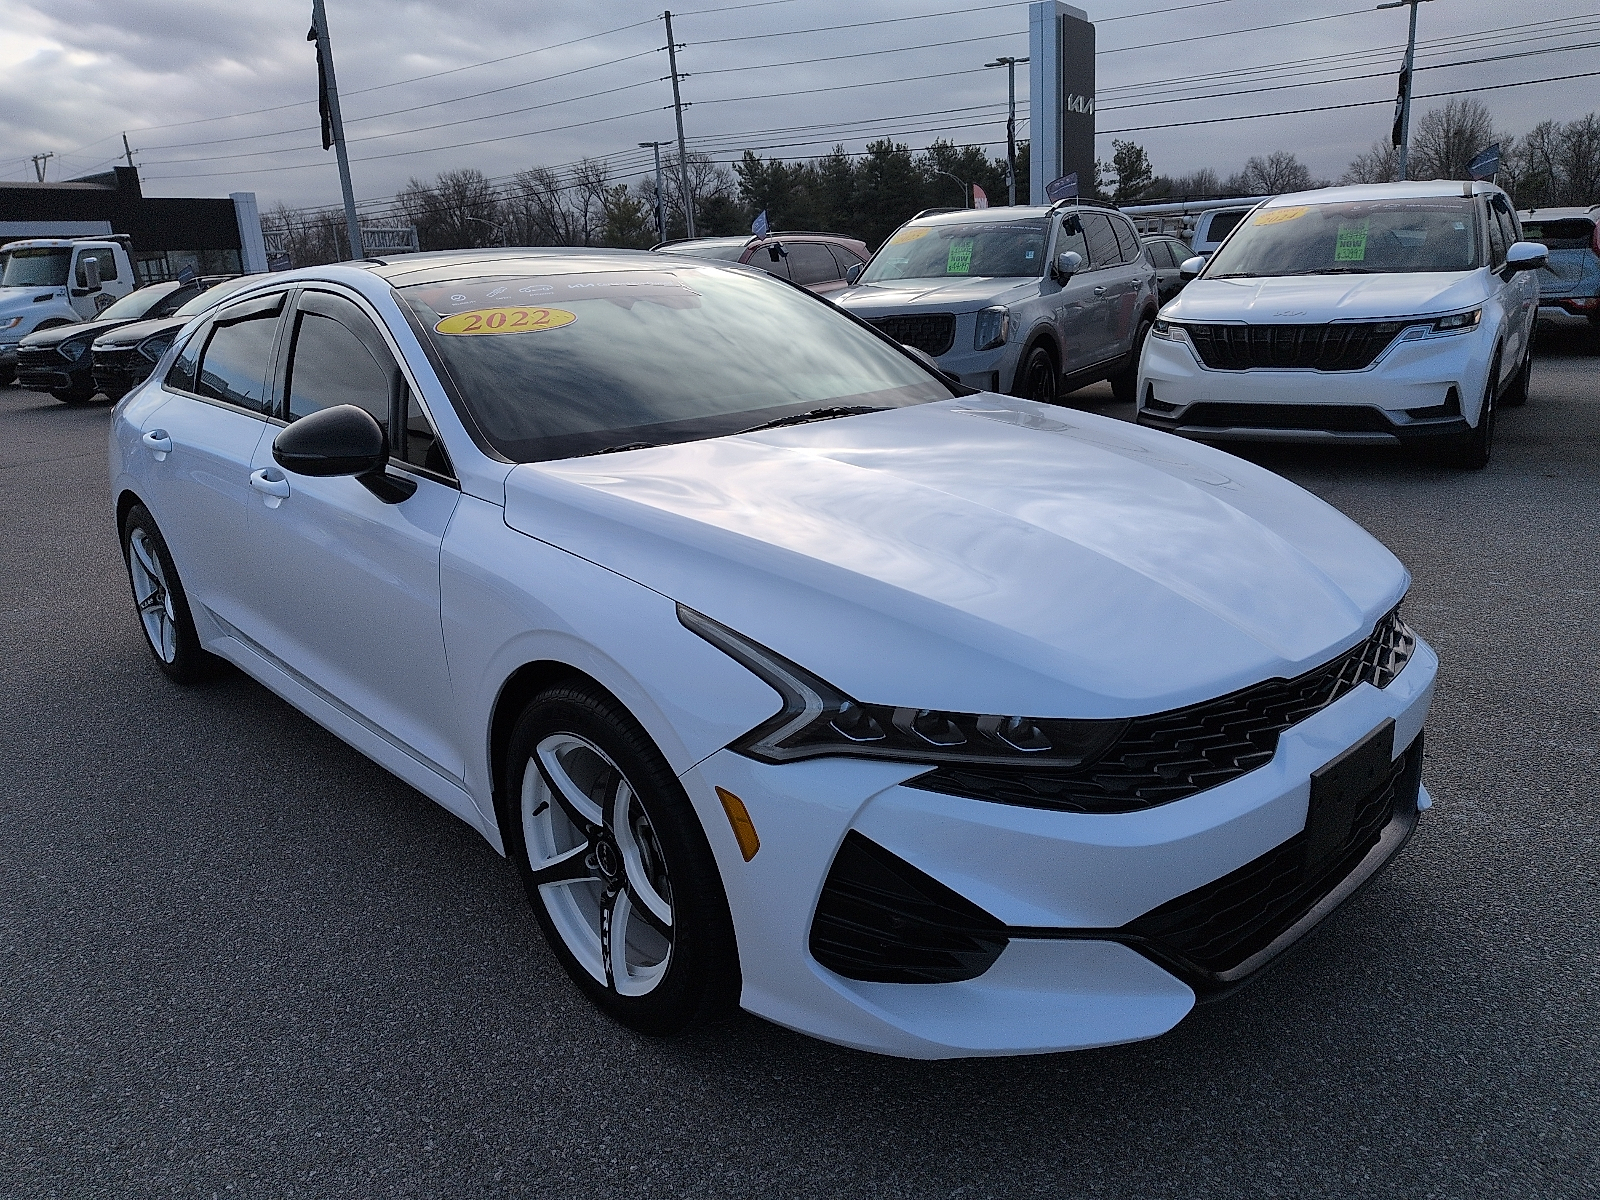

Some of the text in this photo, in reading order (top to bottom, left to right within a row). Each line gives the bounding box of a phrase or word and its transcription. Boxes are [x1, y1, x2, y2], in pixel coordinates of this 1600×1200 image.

[1067, 93, 1094, 115] KIA
[1339, 240, 1363, 248] NOW
[463, 309, 551, 332] 2022
